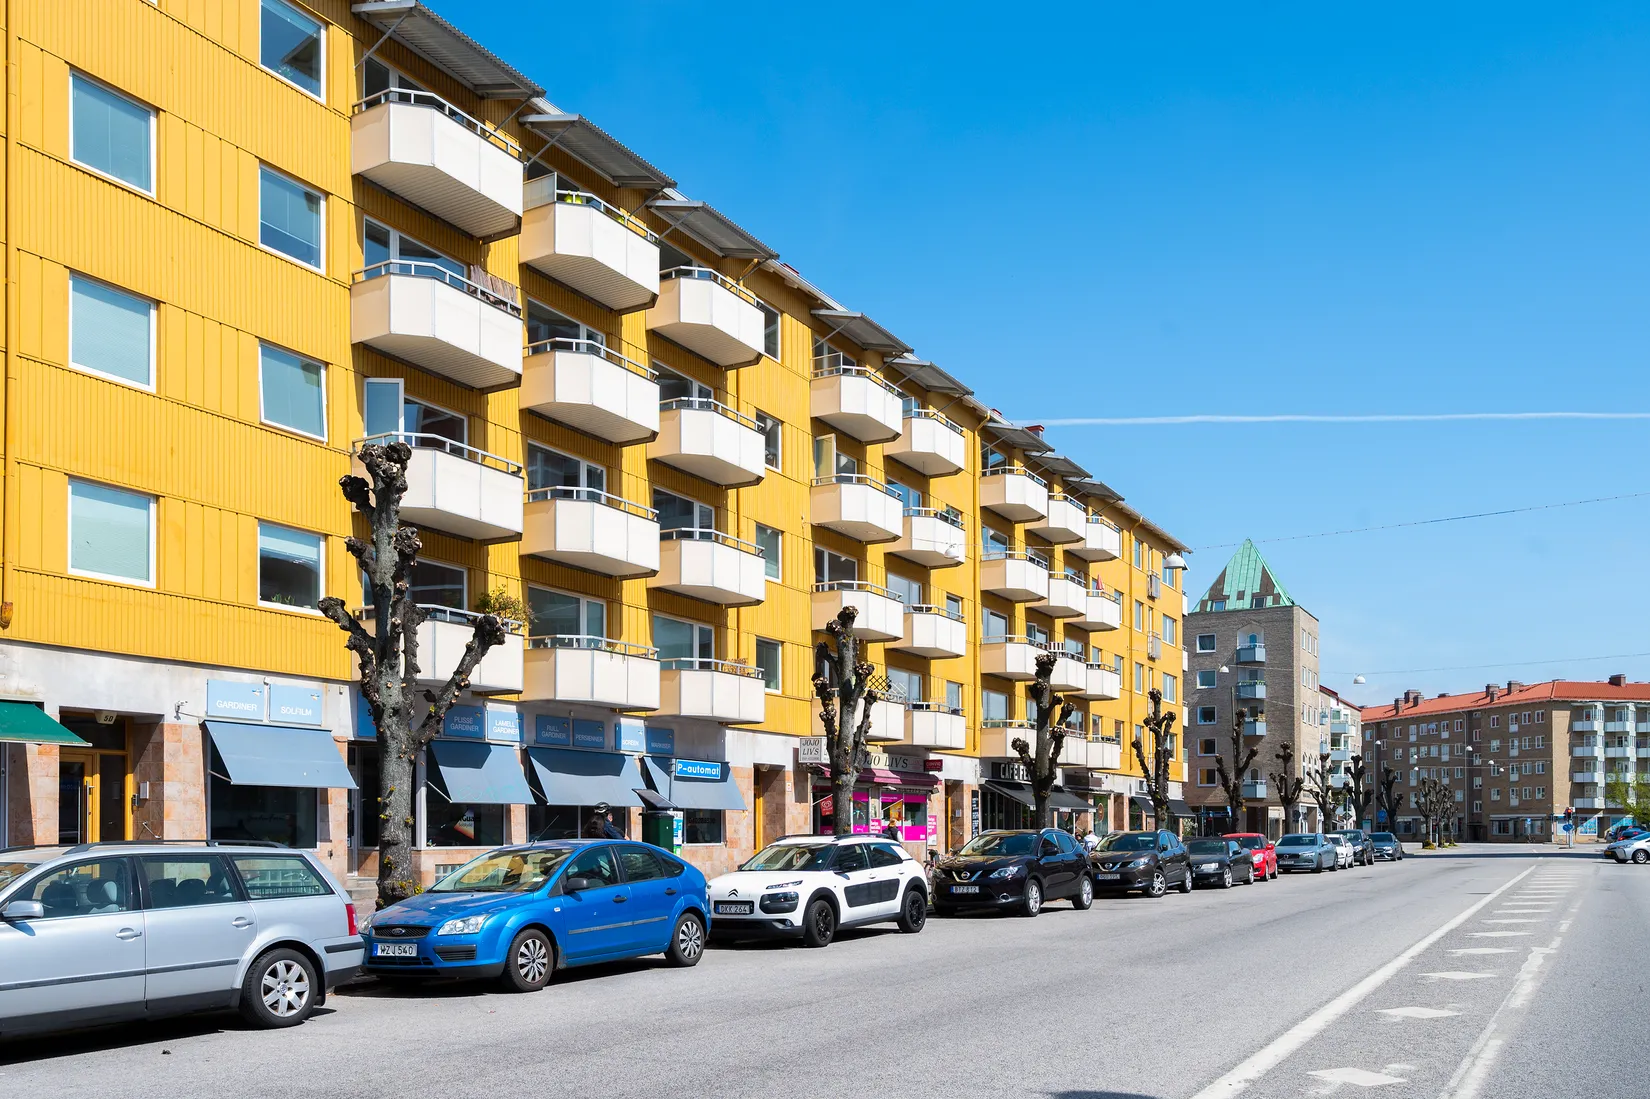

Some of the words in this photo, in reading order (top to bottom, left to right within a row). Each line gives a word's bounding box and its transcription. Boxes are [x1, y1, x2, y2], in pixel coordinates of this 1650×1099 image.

[216, 700, 258, 712] GARDINER
[280, 706, 312, 716] SOLFILM
[450, 723, 479, 732] GARDINER
[495, 719, 516, 728] LAMELL
[546, 724, 559, 732] RULL
[492, 727, 520, 735] GARDINER
[541, 731, 567, 739] GARDINER
[575, 733, 604, 743] PERSIENNER
[677, 763, 720, 776] P-automat
[397, 945, 414, 955] 540
